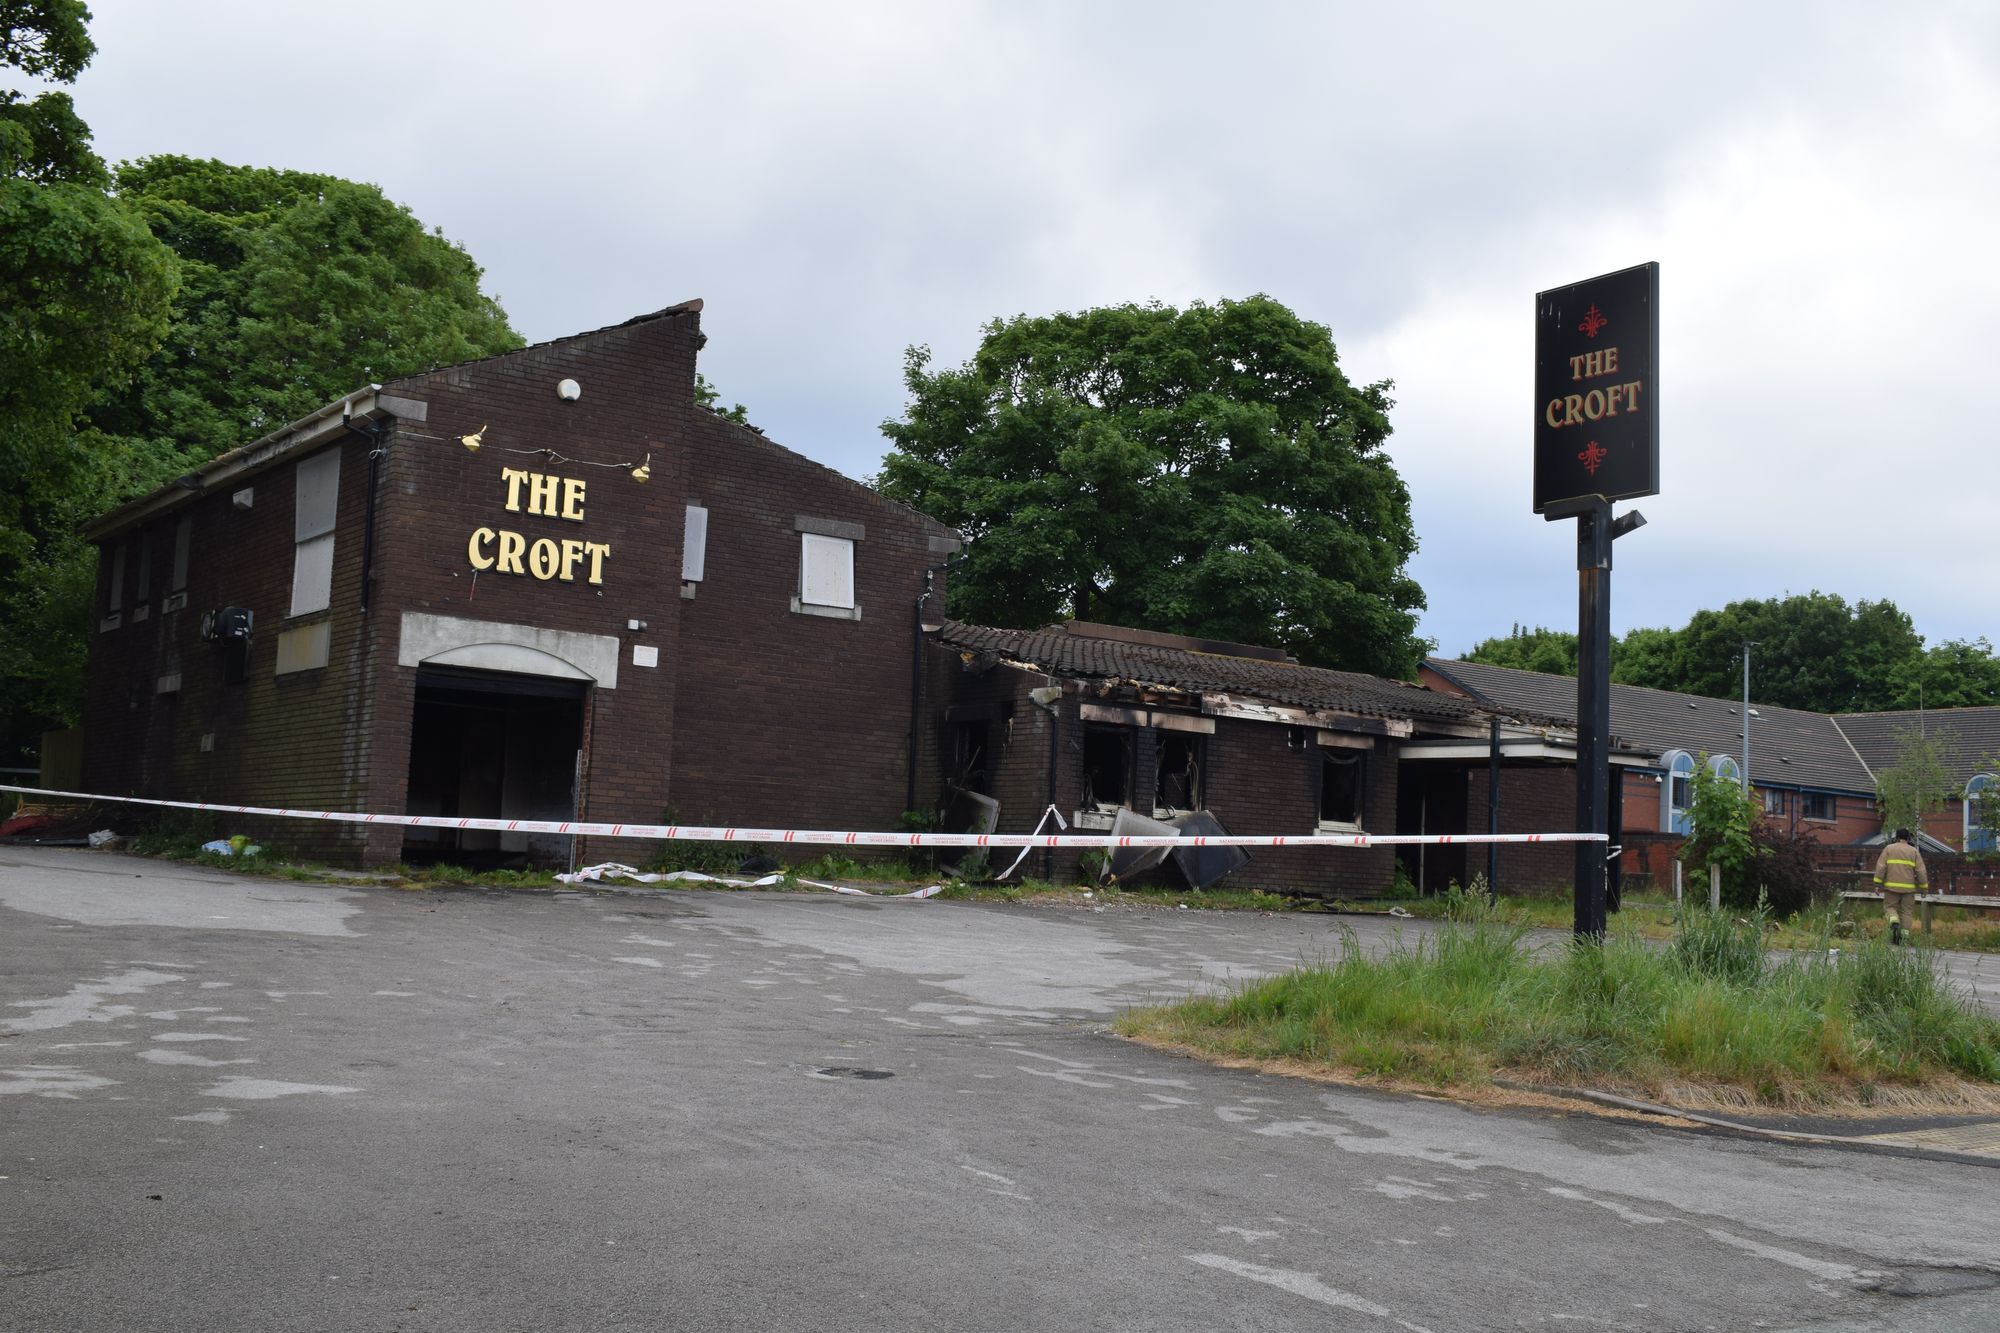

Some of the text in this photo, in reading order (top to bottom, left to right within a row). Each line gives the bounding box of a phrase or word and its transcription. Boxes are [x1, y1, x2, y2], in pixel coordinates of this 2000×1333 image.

[1569, 347, 1618, 381] THE
[1545, 380, 1642, 429] CROFT
[501, 467, 586, 521] THE
[468, 527, 610, 584] CROFT
